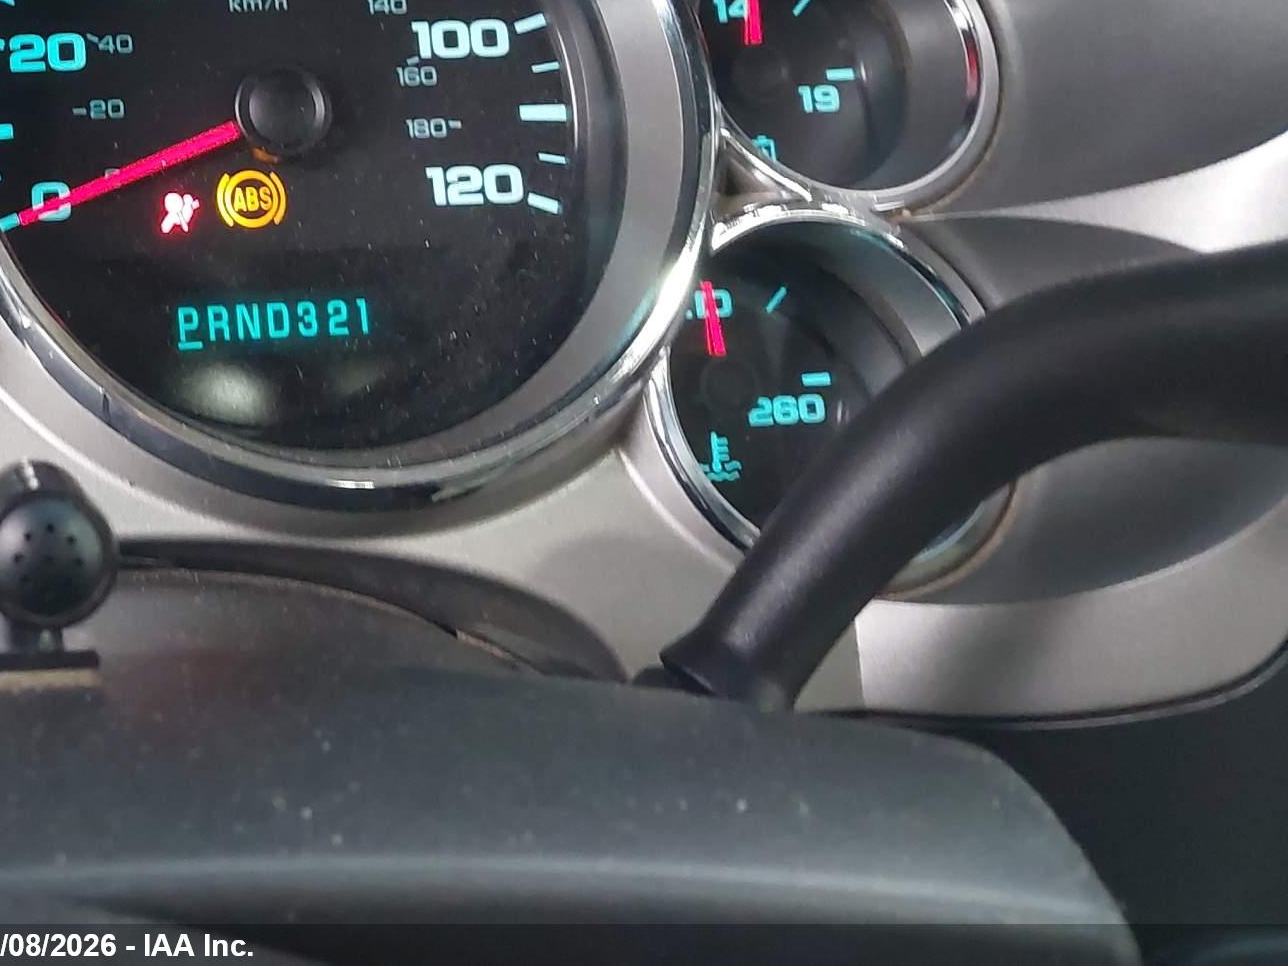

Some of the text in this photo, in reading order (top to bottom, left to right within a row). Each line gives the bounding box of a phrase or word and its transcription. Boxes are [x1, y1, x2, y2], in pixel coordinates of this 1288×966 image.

[9, 32, 87, 72] 20
[98, 35, 134, 55] 40
[412, 19, 510, 60] 100
[396, 65, 438, 87] 160
[89, 98, 125, 120] 20
[798, 84, 841, 114] 19
[406, 117, 447, 138] 180
[425, 163, 525, 206] 120
[233, 186, 272, 214] ABS
[748, 393, 827, 427] 260
